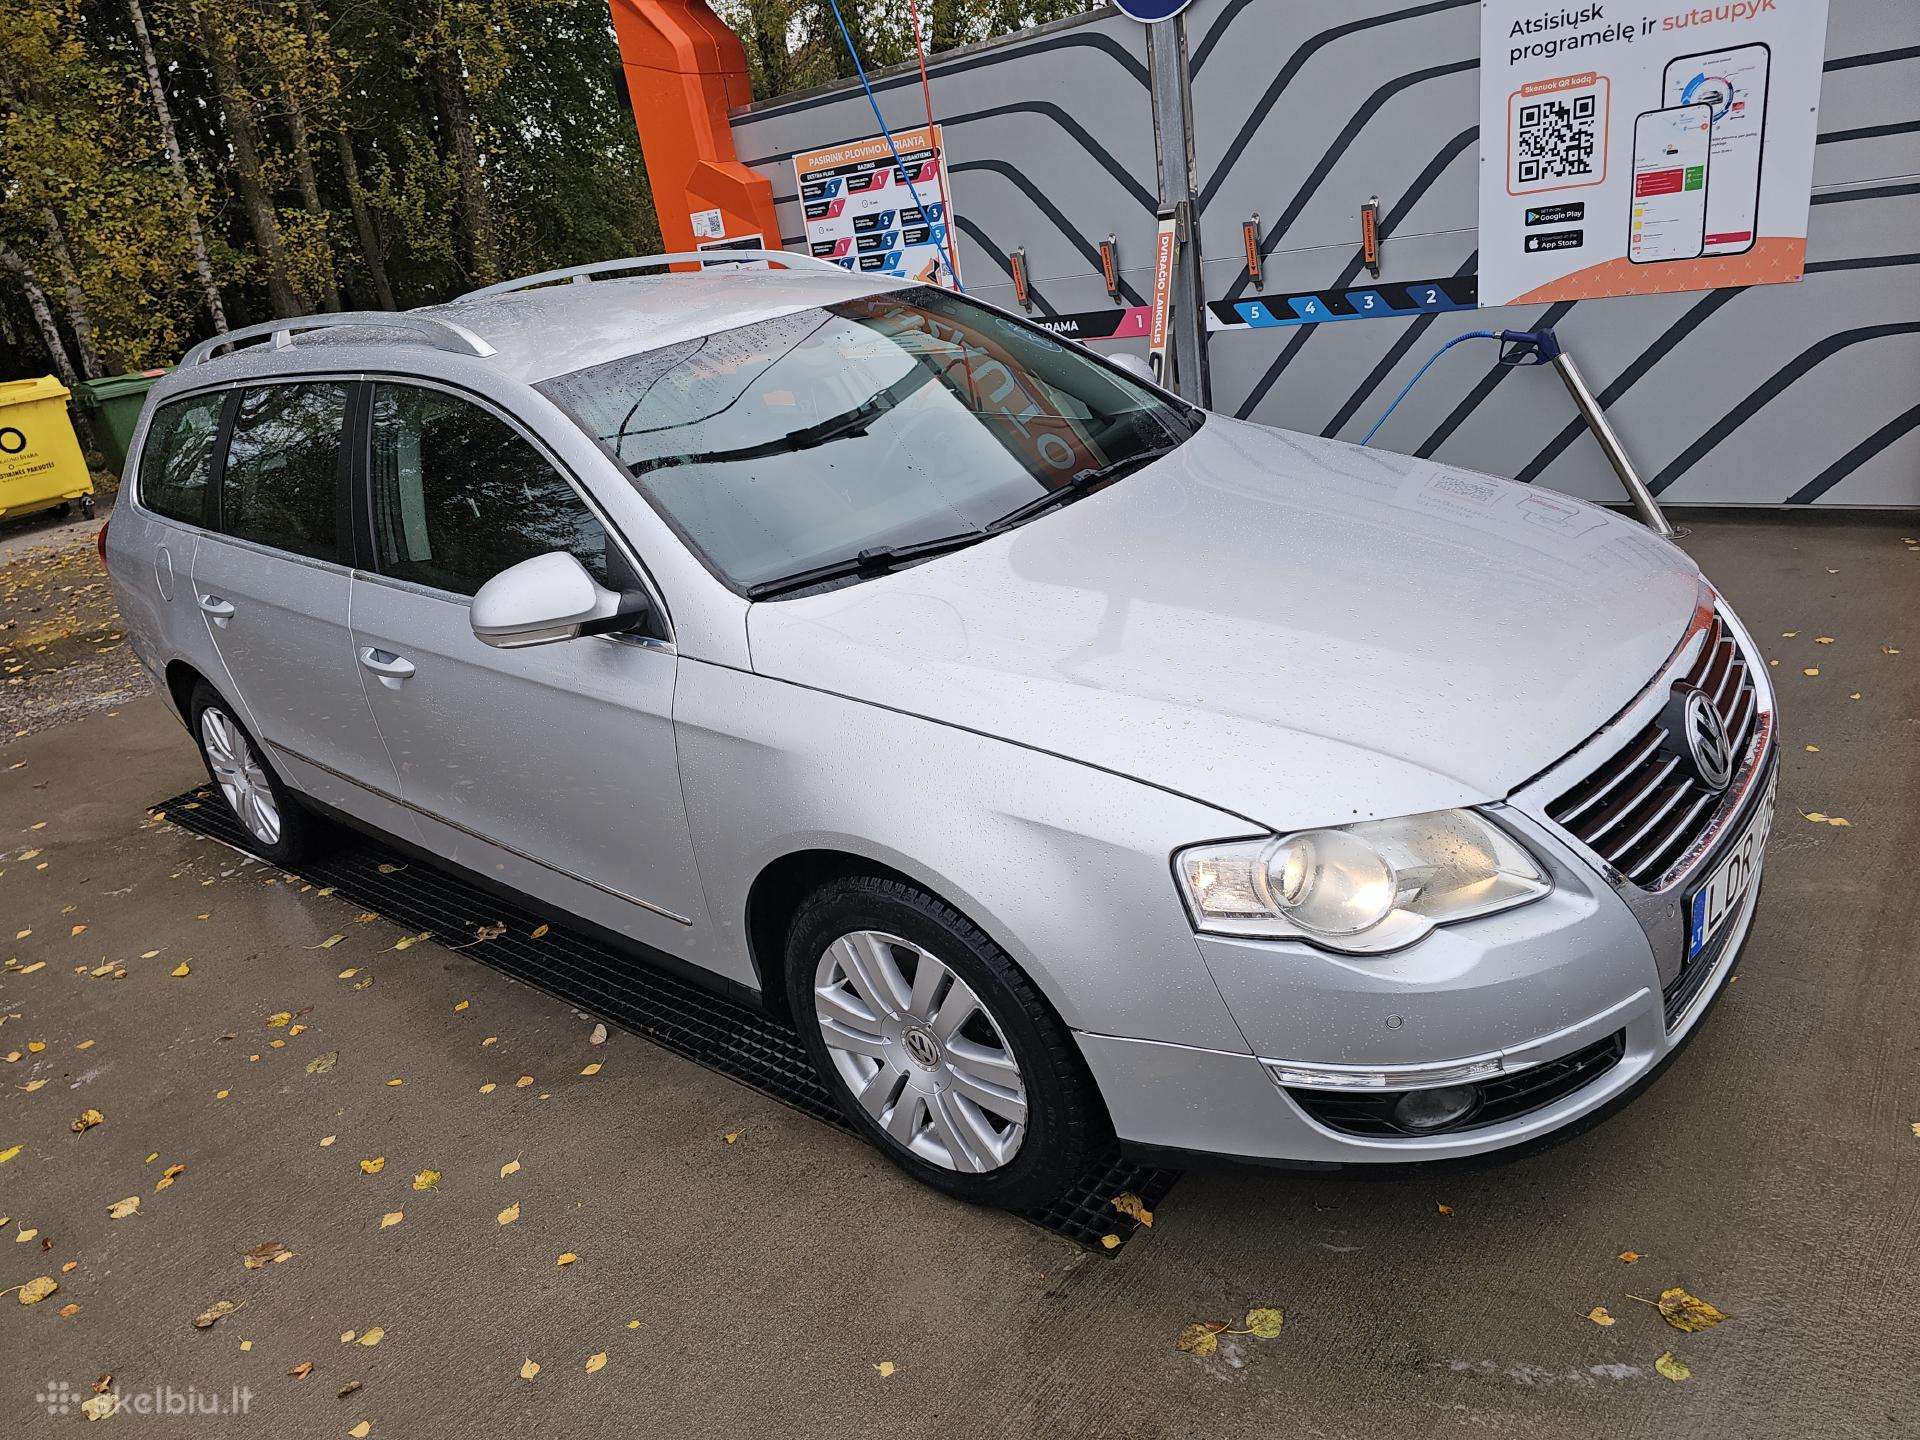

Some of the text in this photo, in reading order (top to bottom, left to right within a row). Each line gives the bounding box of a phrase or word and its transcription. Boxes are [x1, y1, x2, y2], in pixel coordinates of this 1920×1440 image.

[1508, 3, 1604, 38] Atsisiųsk
[1510, 0, 1776, 65] programėlę ir sutaupyk
[1558, 79, 1570, 88] QR
[809, 152, 844, 167] PASIRINK
[844, 145, 882, 160] PLOVIMO
[830, 184, 836, 193] 3
[932, 208, 938, 217] 3
[1540, 212, 1566, 221] Google
[882, 216, 889, 225] 2
[886, 236, 892, 246] 3
[1557, 239, 1577, 247] Store
[889, 256, 895, 266] 4
[1153, 236, 1169, 344] DVIRAČIO LAIKIKLIS
[1251, 289, 1437, 319] 5 4 3 2
[1135, 314, 1144, 329] 1
